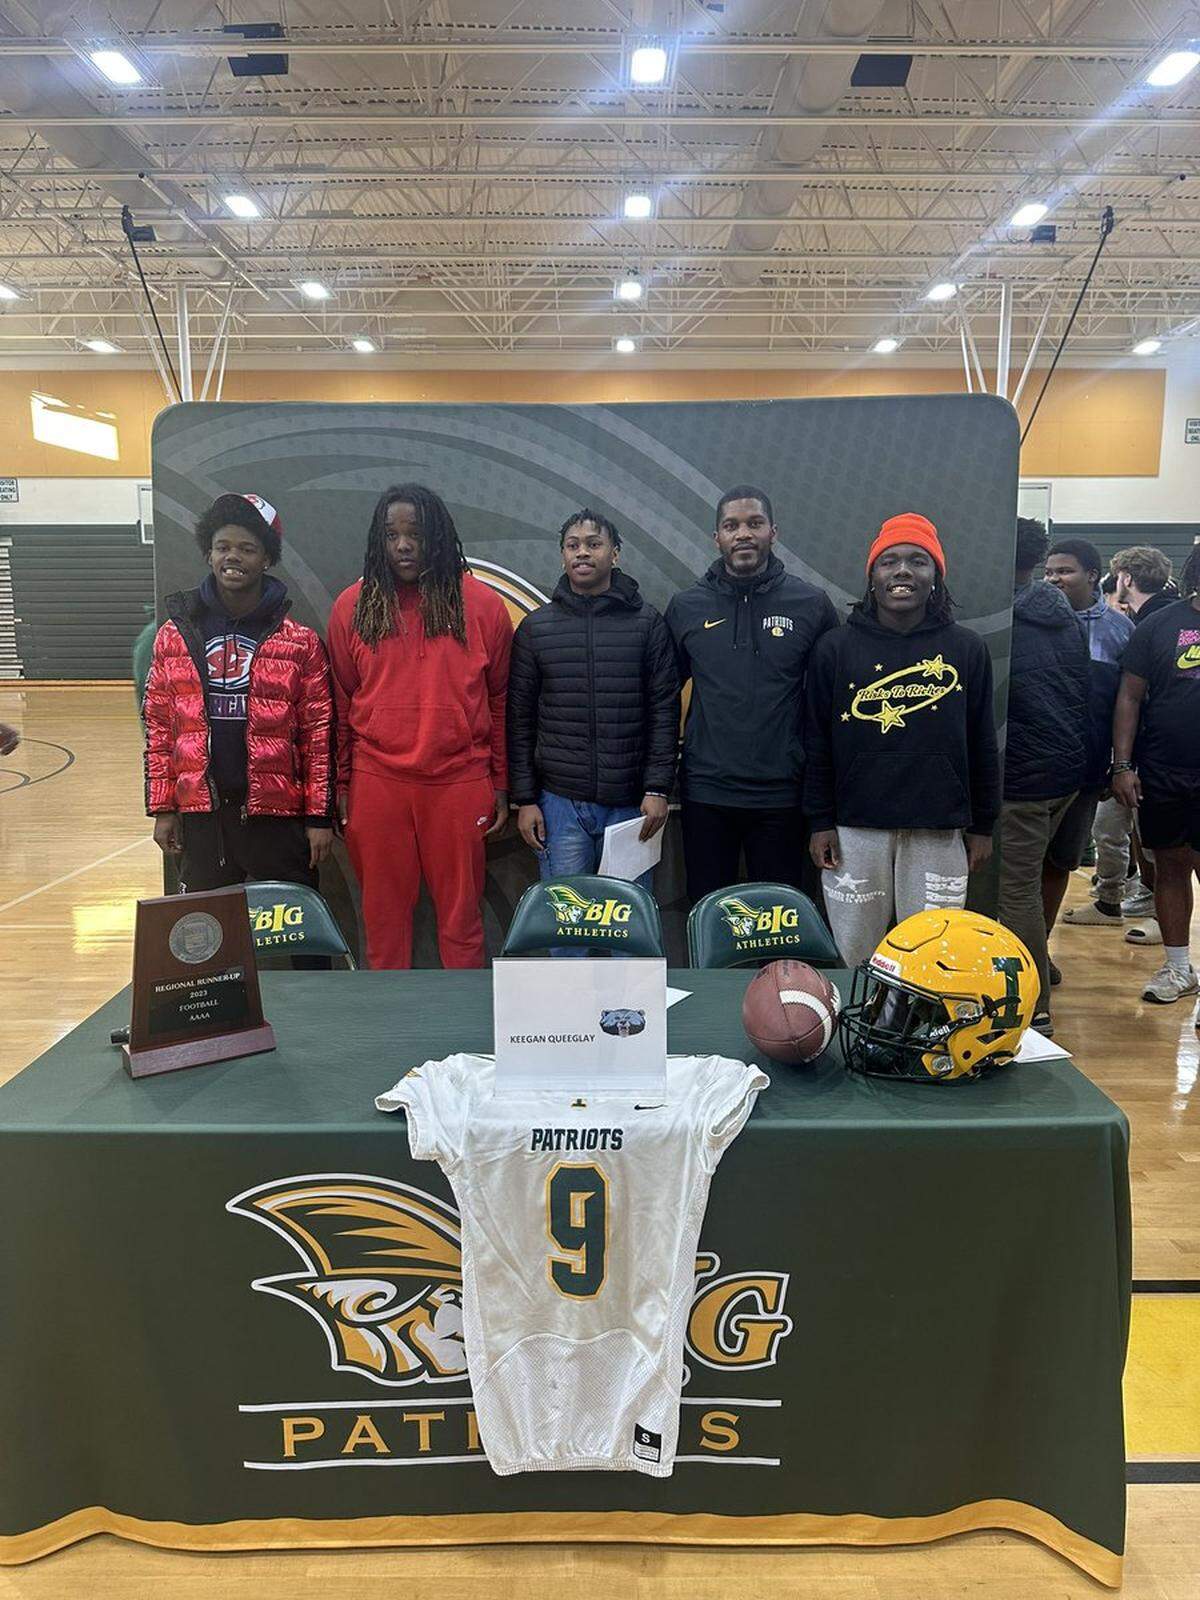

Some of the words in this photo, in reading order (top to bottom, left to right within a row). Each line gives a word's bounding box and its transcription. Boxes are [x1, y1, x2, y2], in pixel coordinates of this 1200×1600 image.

[762, 615, 794, 631] PATRIOTS
[857, 688, 891, 702] Risks
[891, 686, 905, 699] To
[906, 683, 947, 699] Riches
[255, 904, 304, 932] BIG
[585, 899, 632, 926] BIG
[756, 905, 799, 933] BIG
[256, 931, 305, 947] LETICS
[556, 927, 629, 938] ATHLETICS
[735, 934, 801, 950] ATHLETICS
[155, 979, 196, 993] REGIONAL
[197, 972, 240, 986] RUNNER-UP
[189, 990, 208, 999] 2023
[178, 999, 219, 1012] FOOTBALL
[189, 1012, 211, 1022] AAAA
[510, 1034, 546, 1044] KEEGAN
[547, 1034, 596, 1044] QUEEGLAY
[531, 1128, 624, 1151] PATRIOTS
[544, 1160, 610, 1301] 9
[641, 1432, 650, 1444] S
